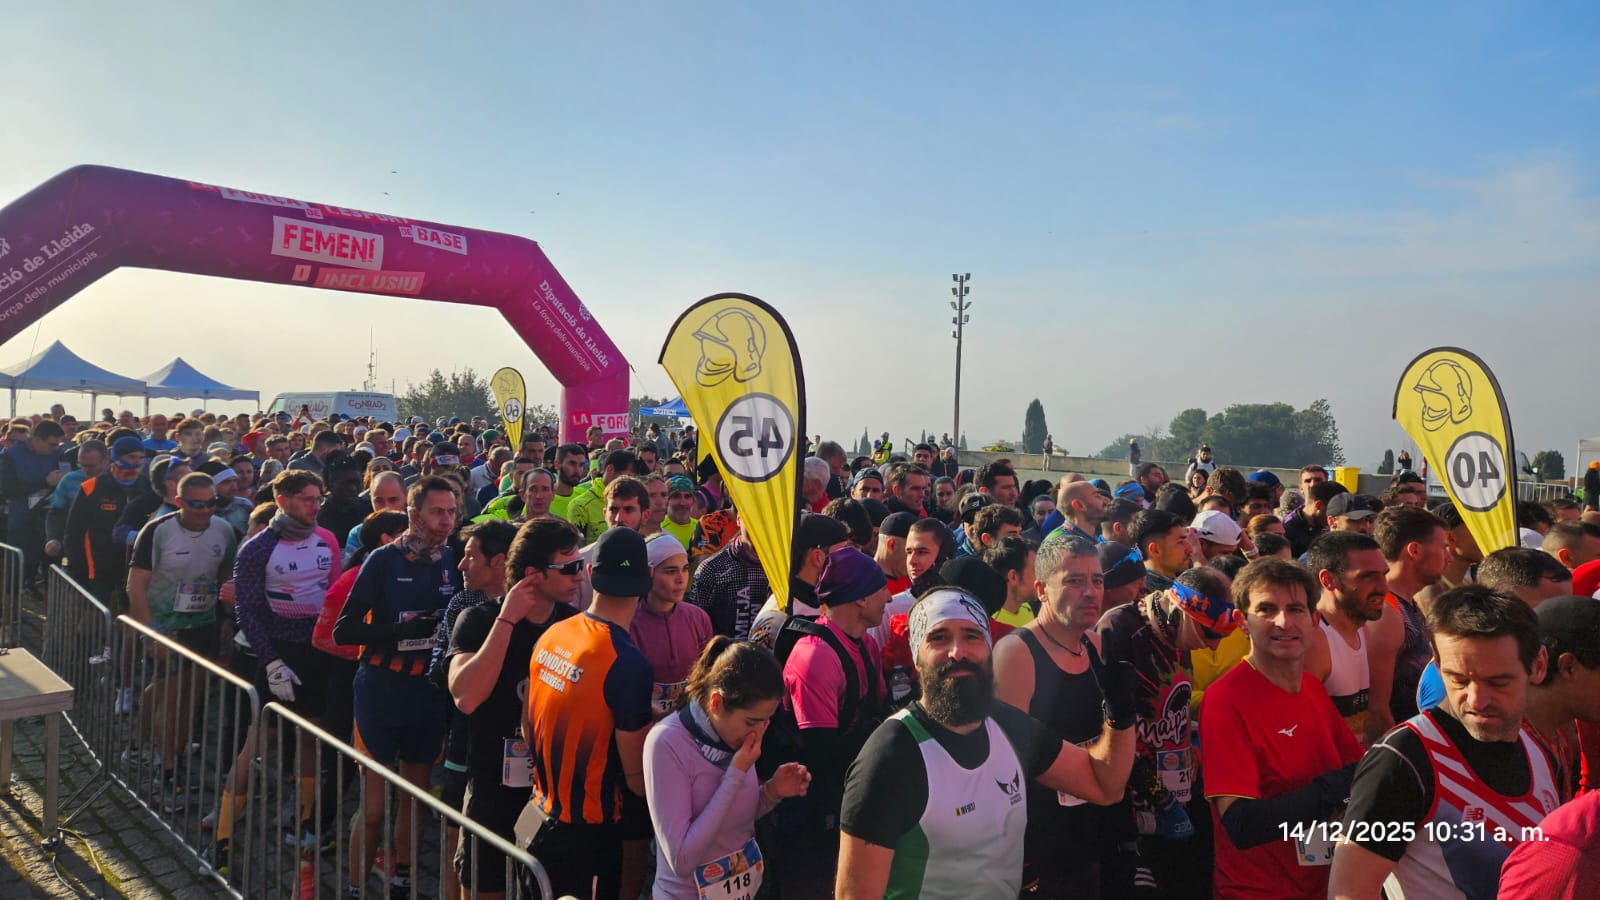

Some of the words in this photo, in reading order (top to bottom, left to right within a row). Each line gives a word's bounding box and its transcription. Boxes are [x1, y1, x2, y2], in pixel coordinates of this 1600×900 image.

[23, 255, 46, 273] de
[40, 223, 95, 260] Lleida
[283, 223, 376, 263] FEMENÍ
[417, 227, 463, 250] BASE
[24, 285, 48, 304] dels
[47, 251, 98, 288] municipis
[323, 271, 418, 292] INCLUSIU
[538, 279, 577, 328] Diputació
[575, 326, 587, 339] de
[584, 336, 609, 369] Lleida
[572, 413, 589, 425] LA
[536, 648, 584, 683] FONDISTES
[723, 872, 751, 894] 118
